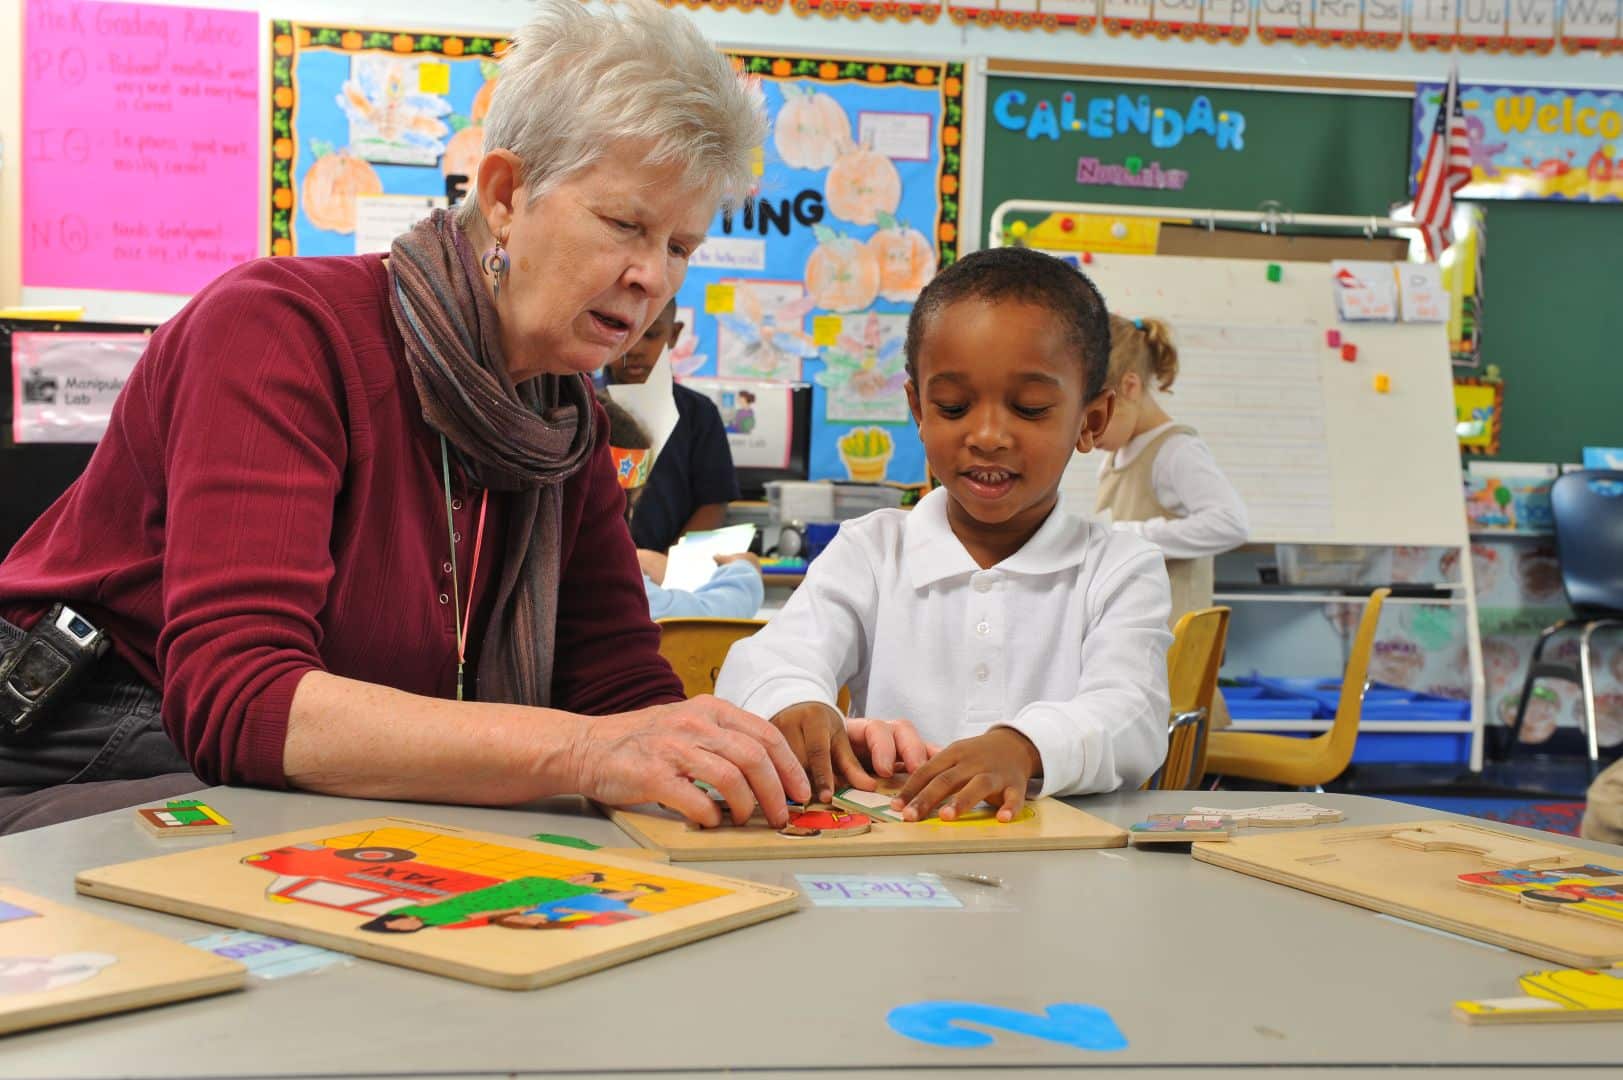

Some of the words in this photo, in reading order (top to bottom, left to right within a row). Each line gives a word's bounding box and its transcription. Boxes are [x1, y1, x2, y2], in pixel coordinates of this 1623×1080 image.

[993, 89, 1246, 151] CALENDAR
[1494, 96, 1622, 140] Welco
[359, 866, 448, 886] TAXI
